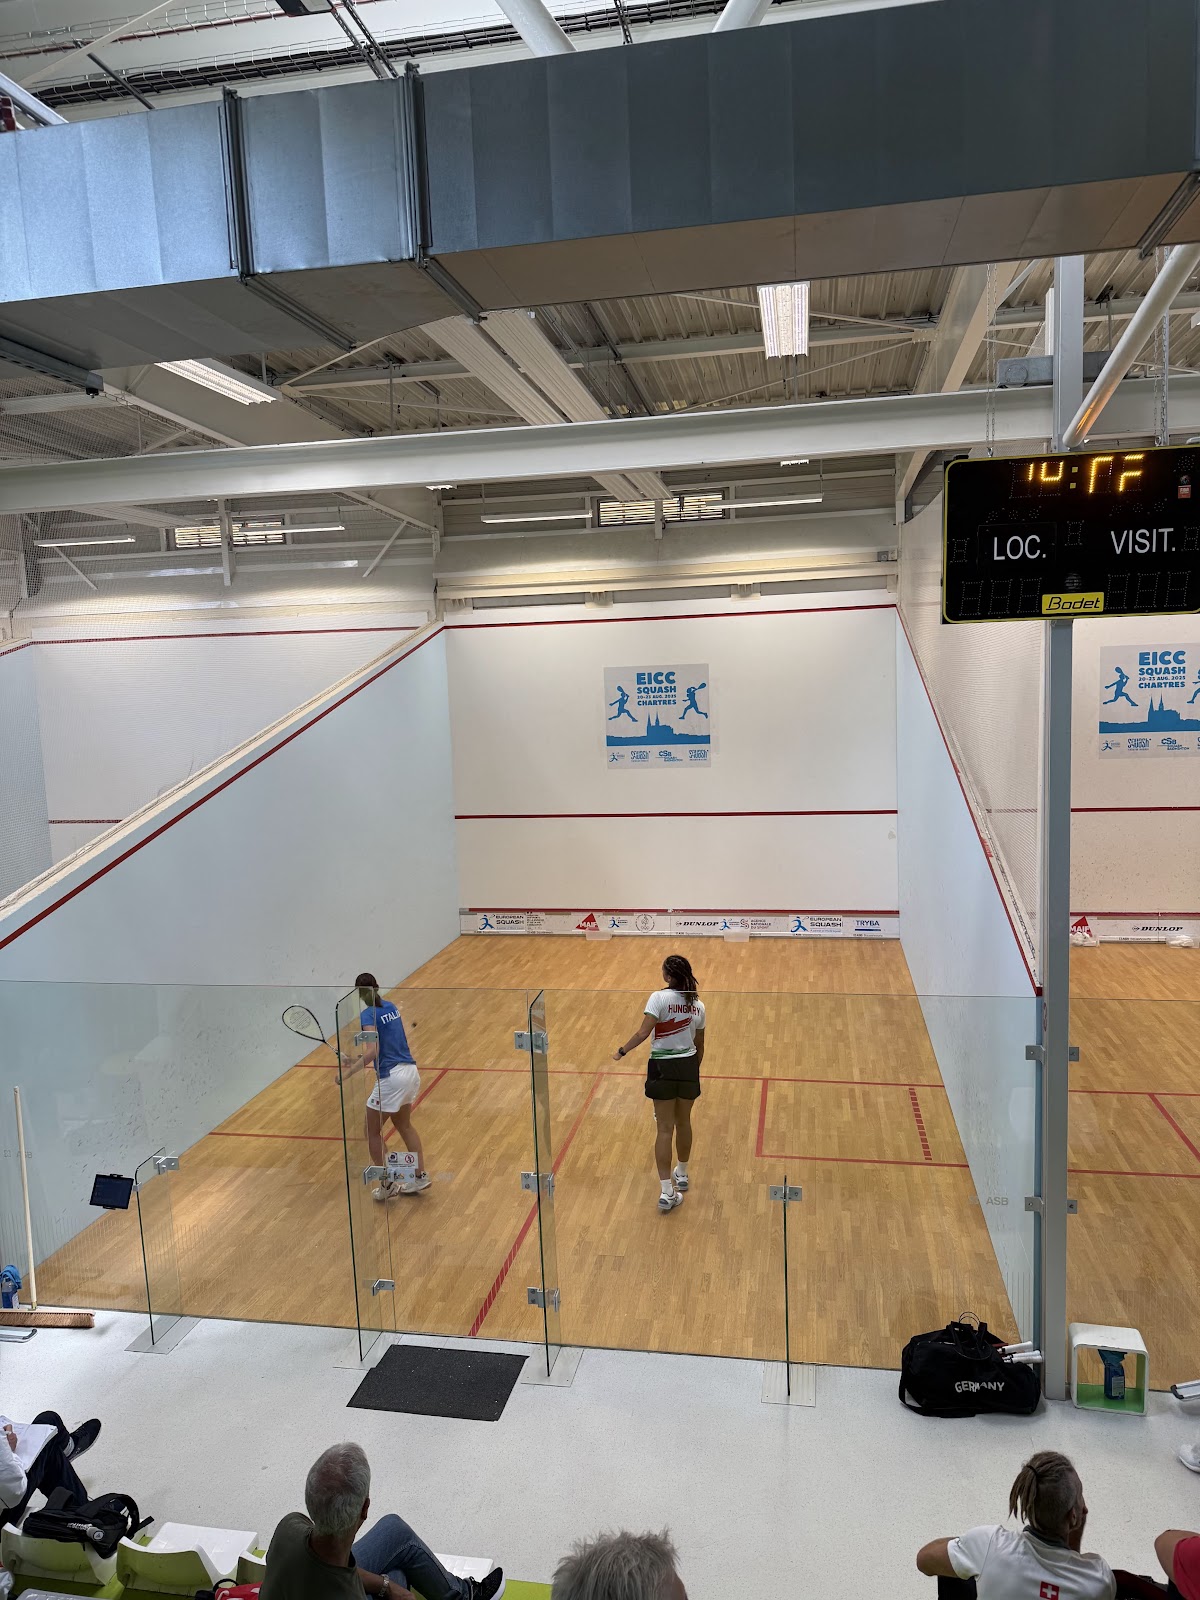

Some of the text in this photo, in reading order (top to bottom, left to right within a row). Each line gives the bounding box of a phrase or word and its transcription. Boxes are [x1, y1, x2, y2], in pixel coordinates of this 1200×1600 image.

[993, 534, 1047, 561] LOC.
[1110, 527, 1177, 555] VISIT.
[1045, 596, 1101, 611] Bodet
[1138, 650, 1186, 666] EICC
[636, 671, 676, 685] EICC
[1138, 667, 1186, 676] SQUASH
[637, 686, 677, 695] SQUASH
[986, 1196, 1009, 1206] ASB
[954, 1380, 1005, 1393] GERMANY
